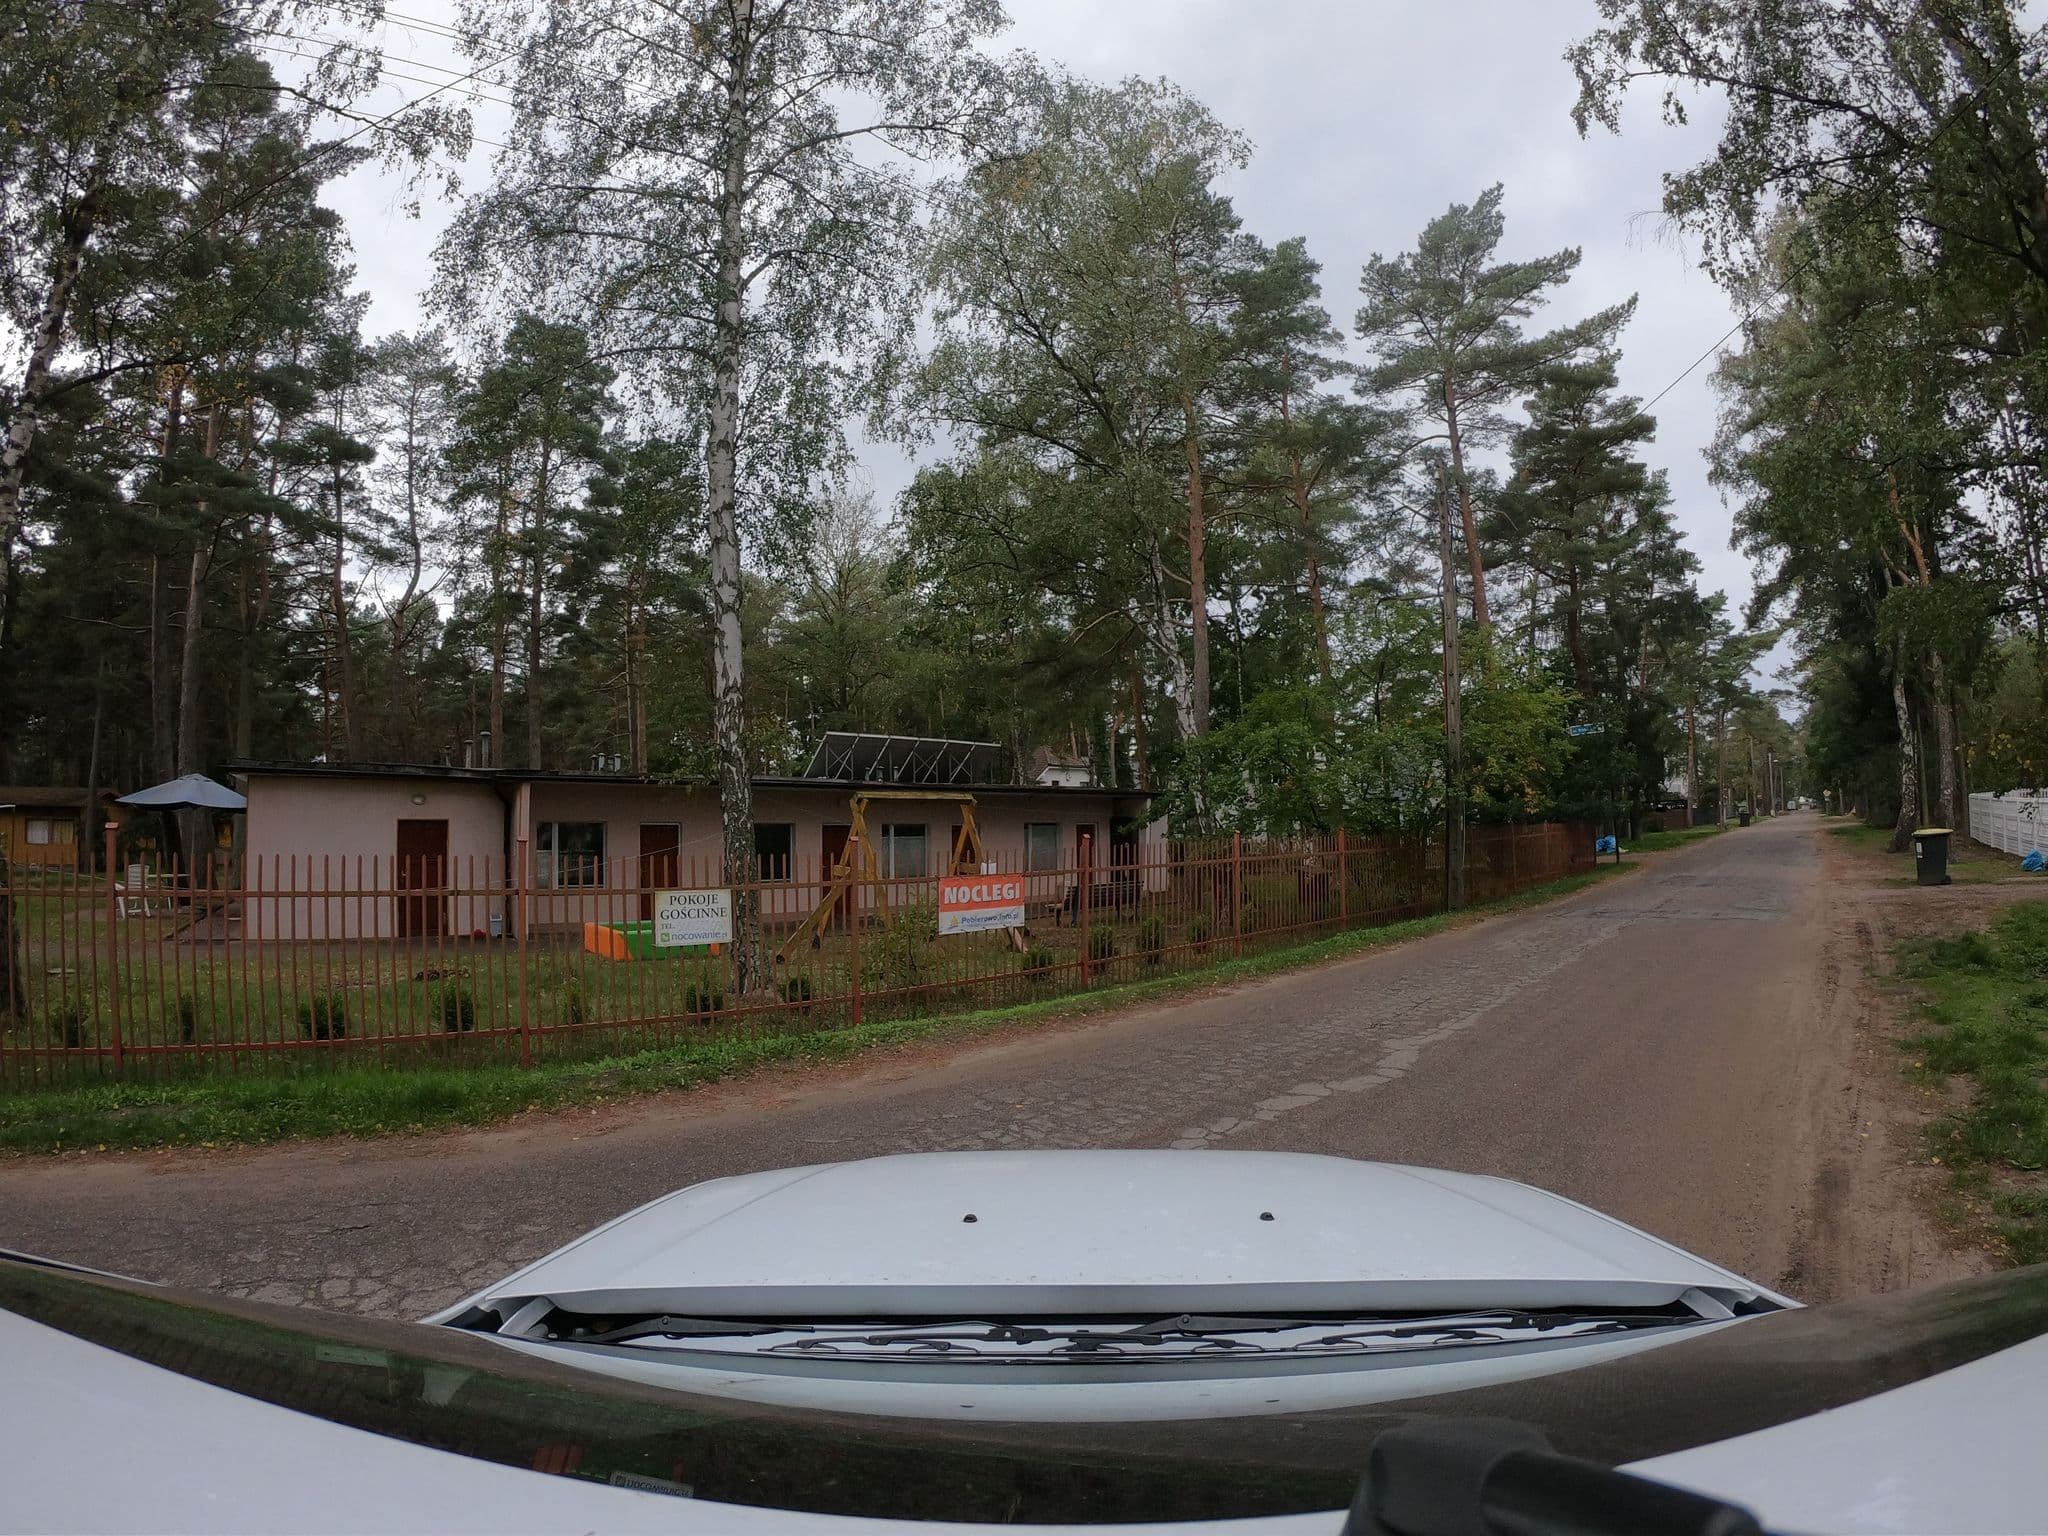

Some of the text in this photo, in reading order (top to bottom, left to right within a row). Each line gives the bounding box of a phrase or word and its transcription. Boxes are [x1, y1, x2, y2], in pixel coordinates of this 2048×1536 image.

[669, 893, 719, 907] POKOJE
[943, 882, 1020, 904] NOCLEGI
[660, 906, 728, 920] GOŚCINNE
